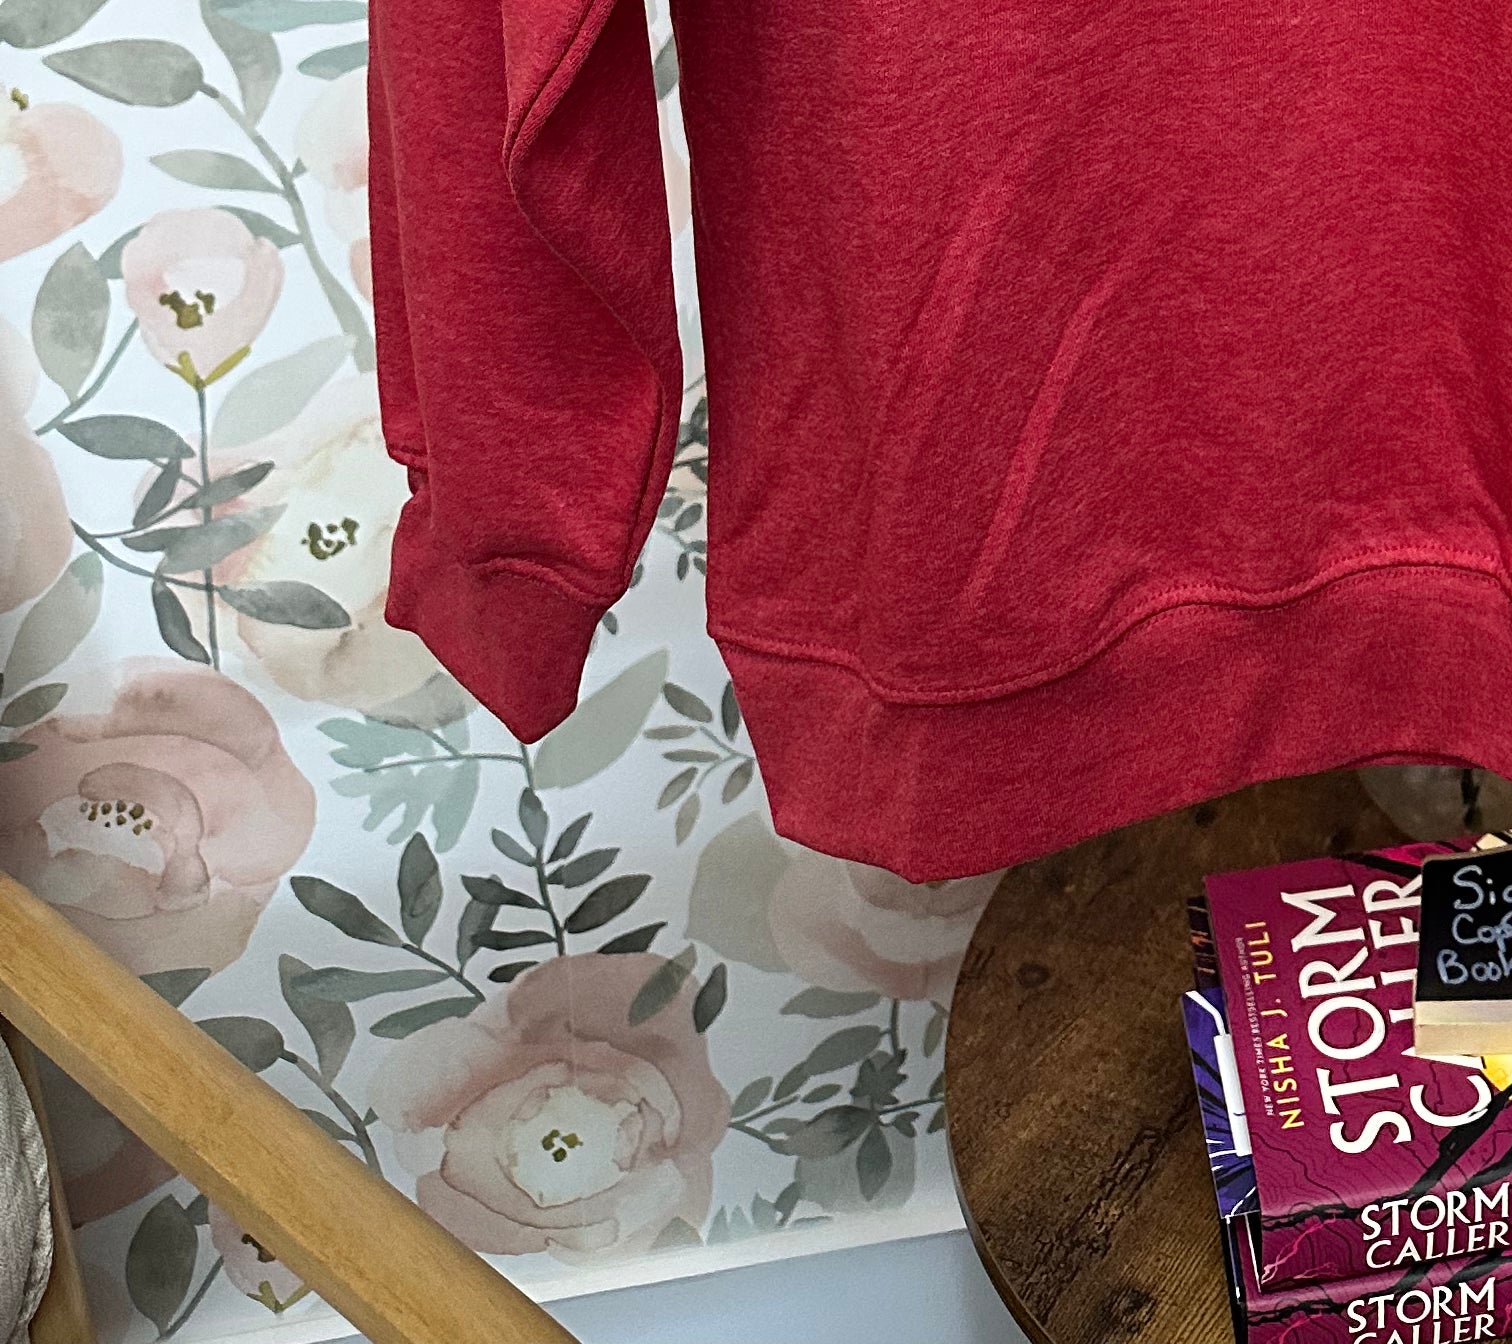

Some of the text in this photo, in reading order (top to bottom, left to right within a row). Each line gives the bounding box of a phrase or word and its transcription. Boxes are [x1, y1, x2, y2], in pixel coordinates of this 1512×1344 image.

[1245, 920, 1305, 1130] NISHA J. TULI
[1280, 883, 1412, 1154] STORM
[1360, 1181, 1511, 1241] STORM
[1365, 1220, 1511, 1269] CALLER
[1346, 1276, 1497, 1334] STORM
